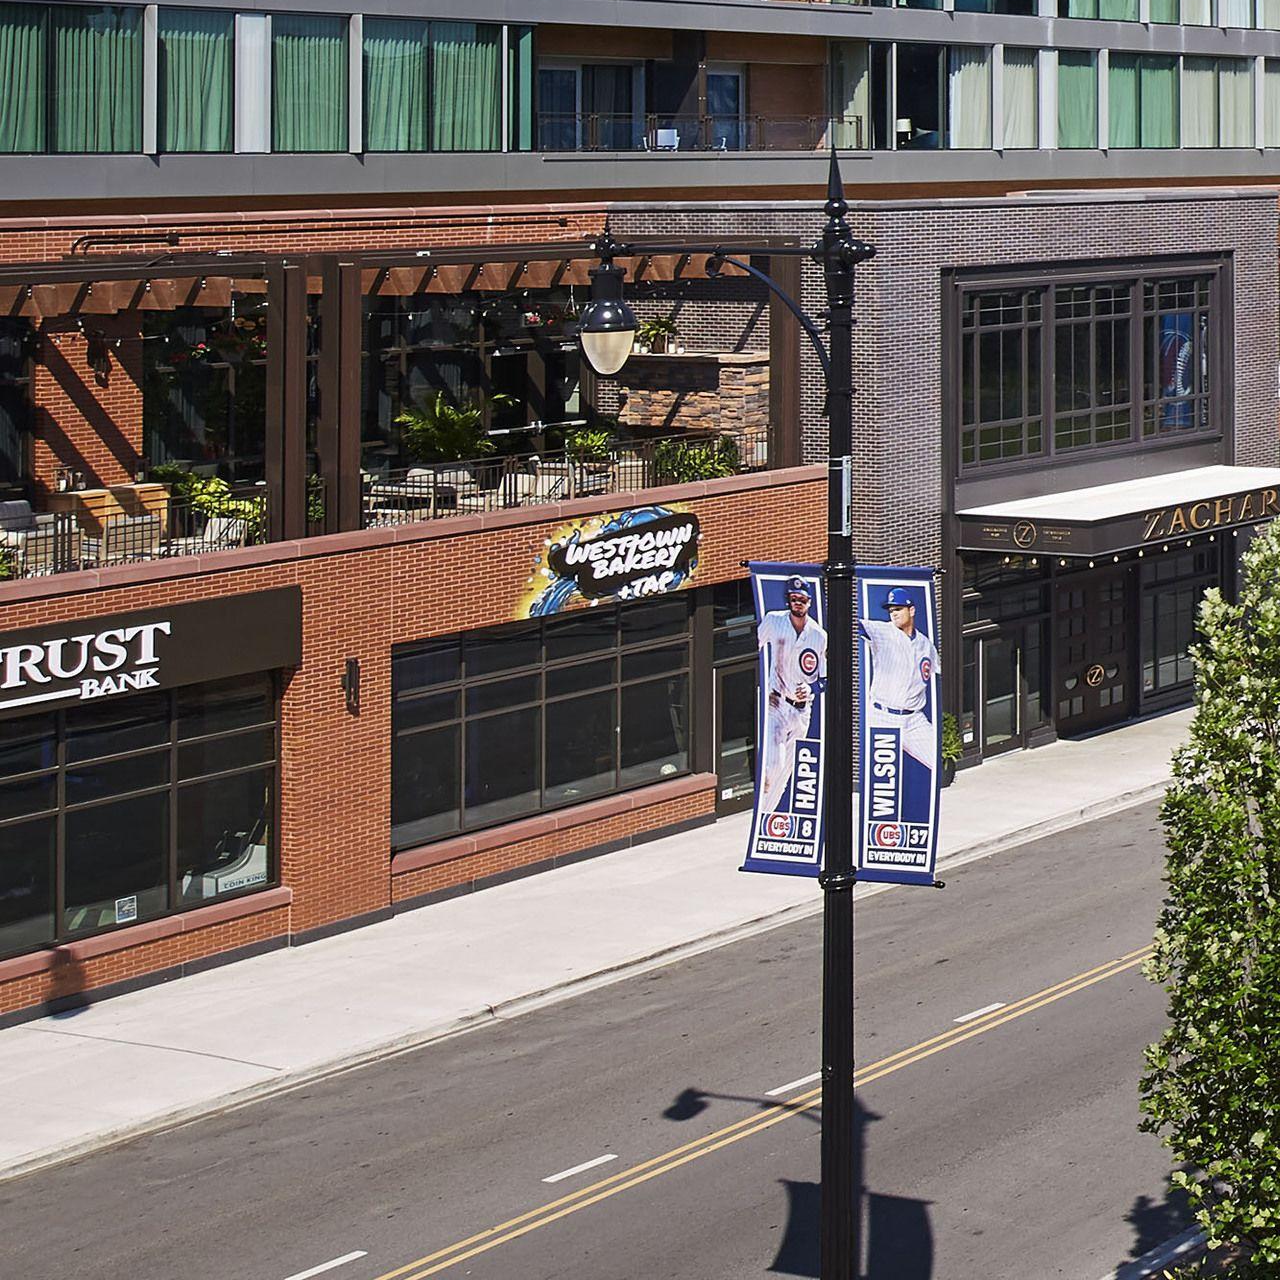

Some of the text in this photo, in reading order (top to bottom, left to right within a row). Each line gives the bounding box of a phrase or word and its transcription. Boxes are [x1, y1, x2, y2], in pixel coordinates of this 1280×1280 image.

[591, 545, 684, 580] BAKERY
[0, 621, 171, 689] RUST
[80, 667, 160, 700] BANK
[795, 748, 818, 810] HAPP
[872, 733, 896, 818] WILSON
[767, 814, 812, 838] CUBS 8
[876, 824, 928, 847] CUBS 37
[758, 842, 813, 856] EVERYBODY IN
[868, 851, 926, 865] EVERYBODY IN
[224, 873, 266, 889] COIN KING
